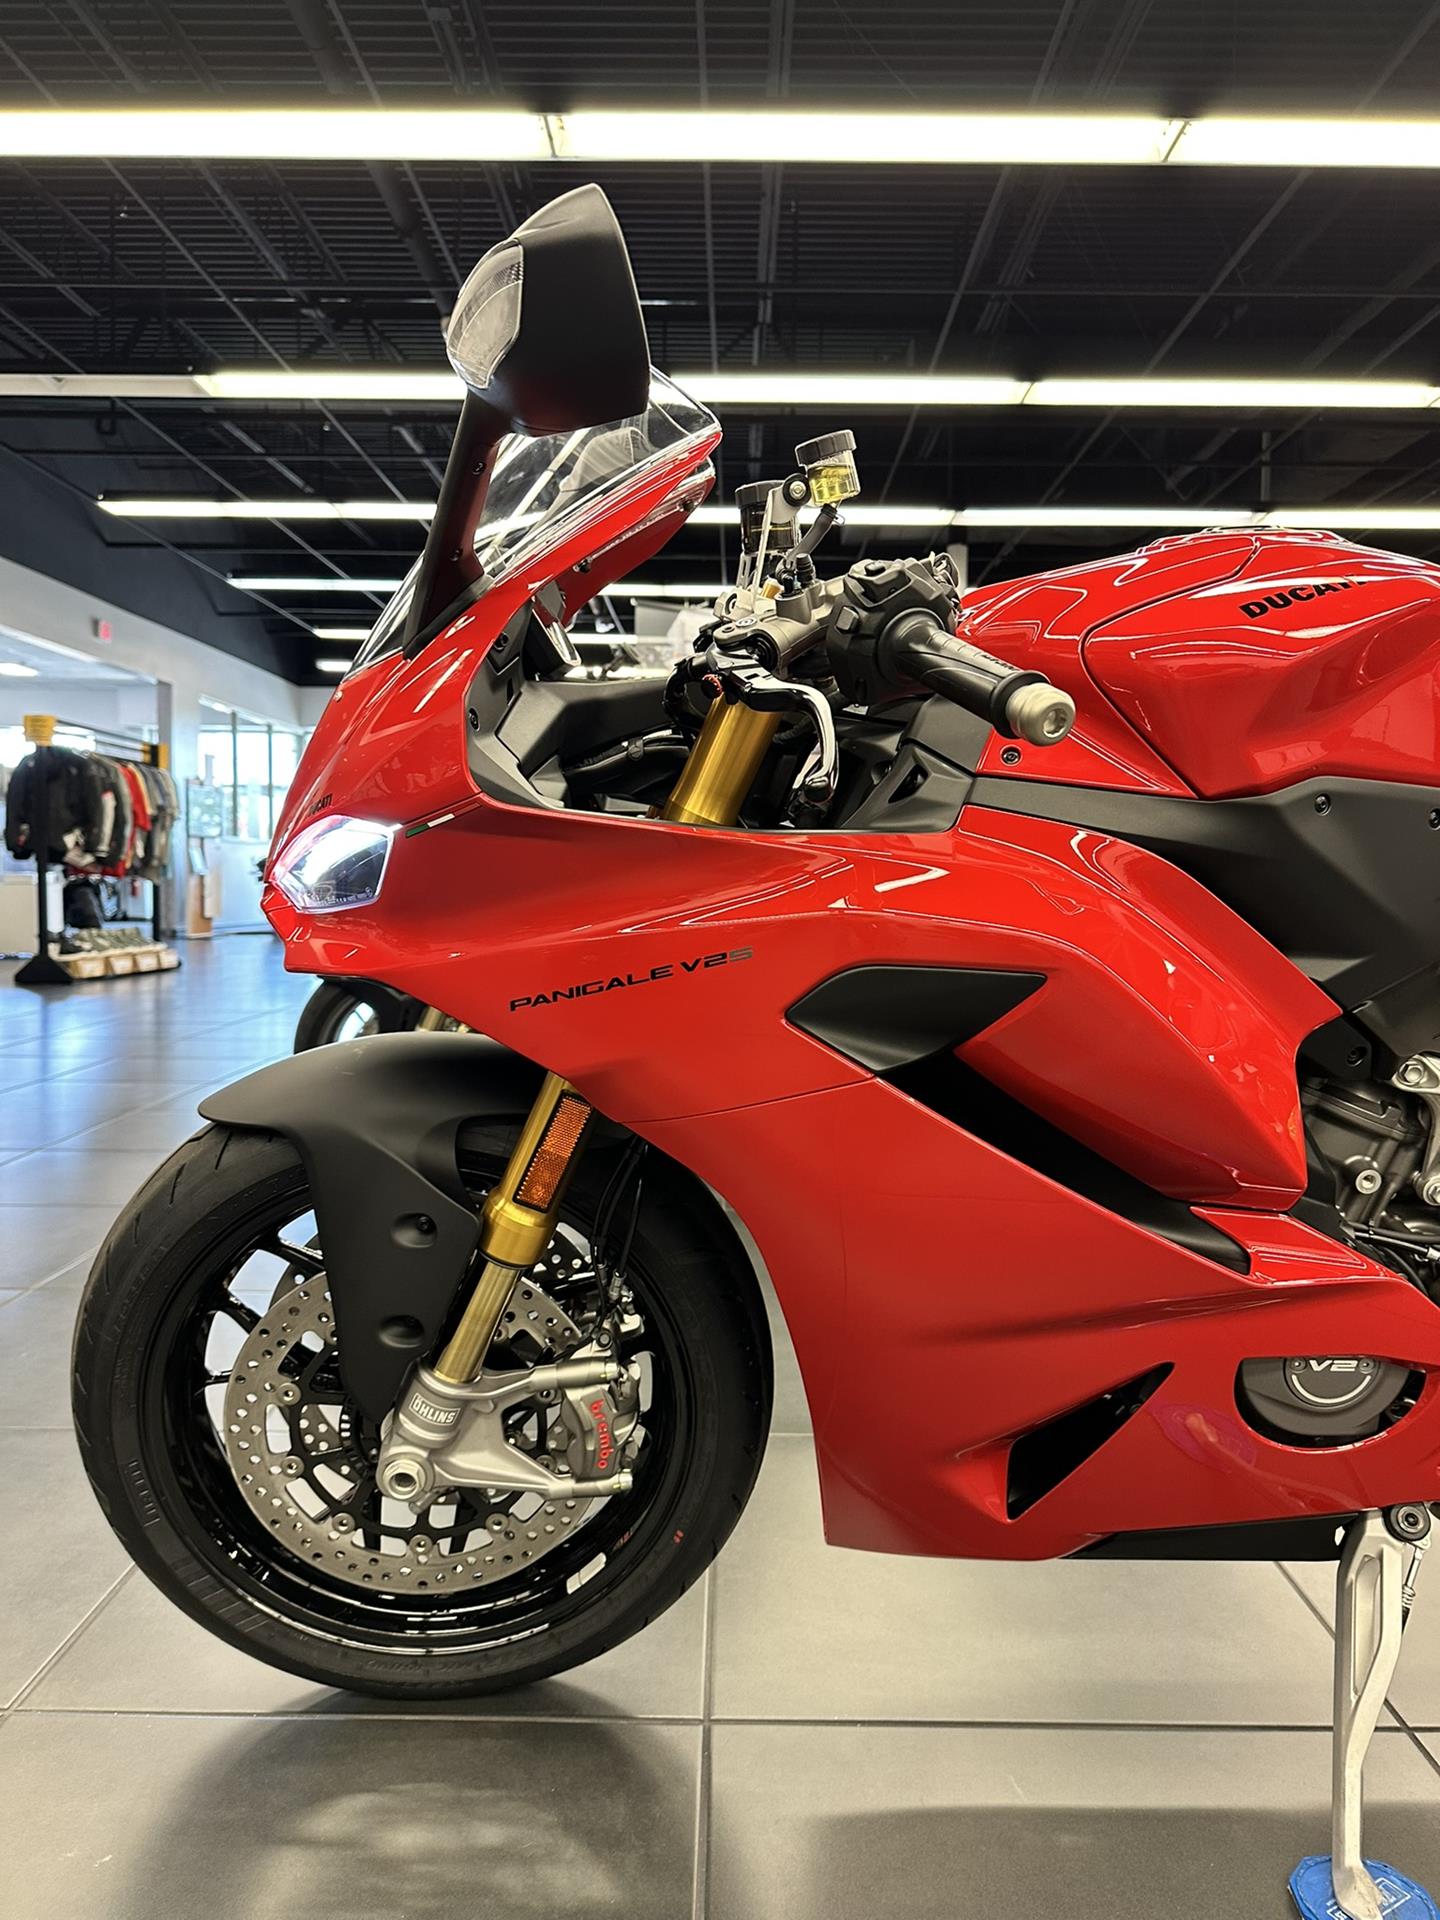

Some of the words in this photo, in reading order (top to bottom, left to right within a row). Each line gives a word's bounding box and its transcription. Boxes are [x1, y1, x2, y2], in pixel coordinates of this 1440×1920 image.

[1239, 574, 1367, 618] DUCAT
[509, 964, 674, 1012] PANIGALE
[1309, 1359, 1358, 1372] V2
[412, 1395, 456, 1423] ÖHLINS
[591, 1399, 614, 1470] brembo
